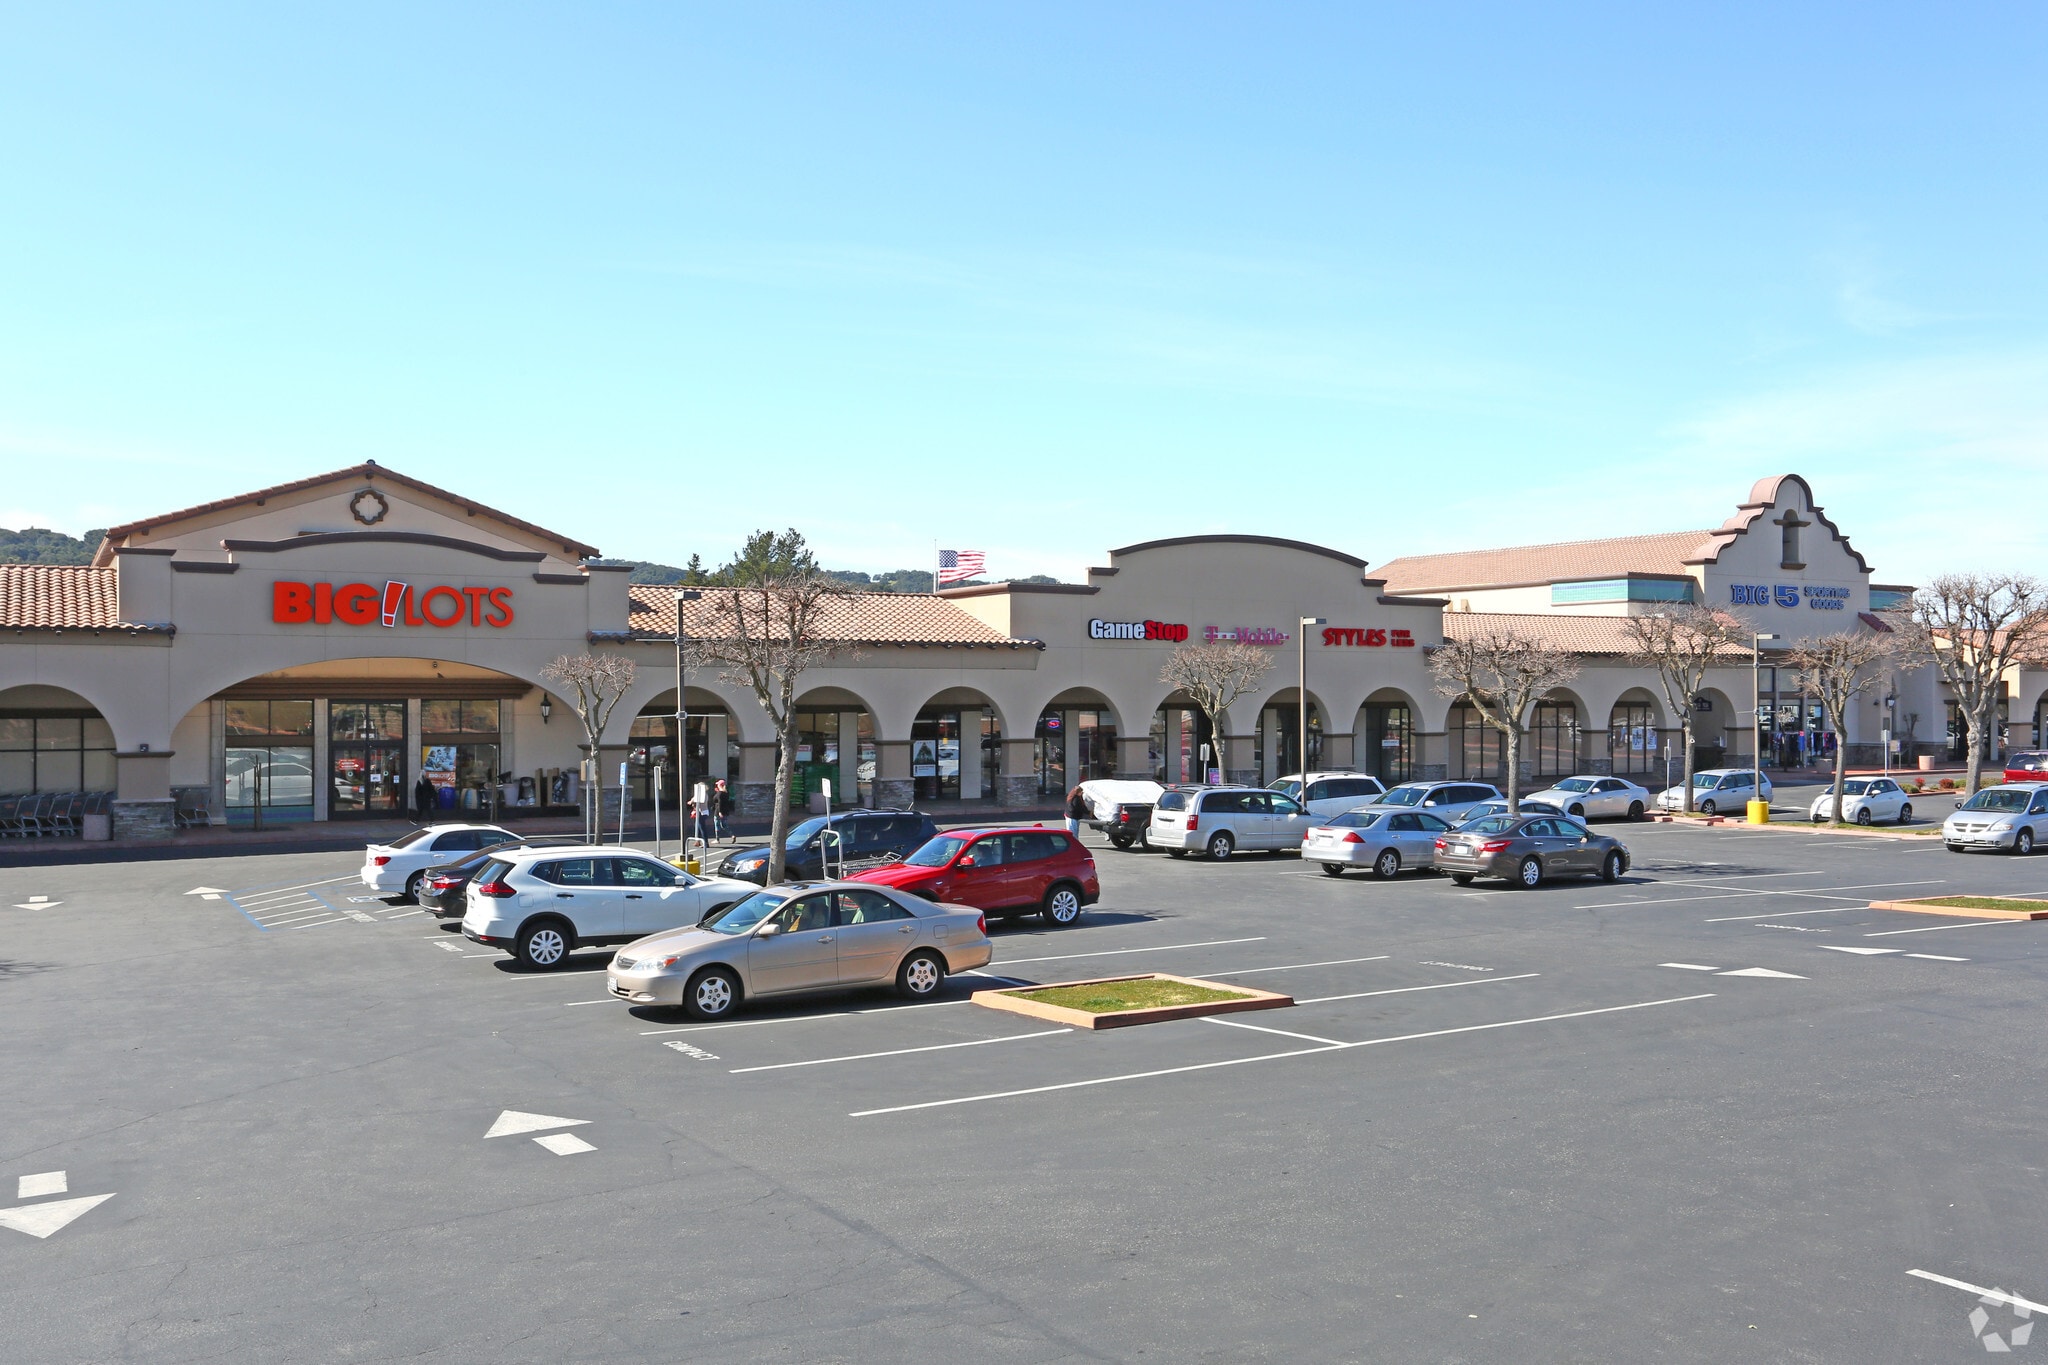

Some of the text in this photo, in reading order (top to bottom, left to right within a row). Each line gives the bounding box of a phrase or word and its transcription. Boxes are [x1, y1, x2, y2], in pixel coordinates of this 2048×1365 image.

[1731, 584, 1800, 608] BIG 5
[1088, 618, 1189, 643] GameStop
[1322, 627, 1387, 646] STYLES
